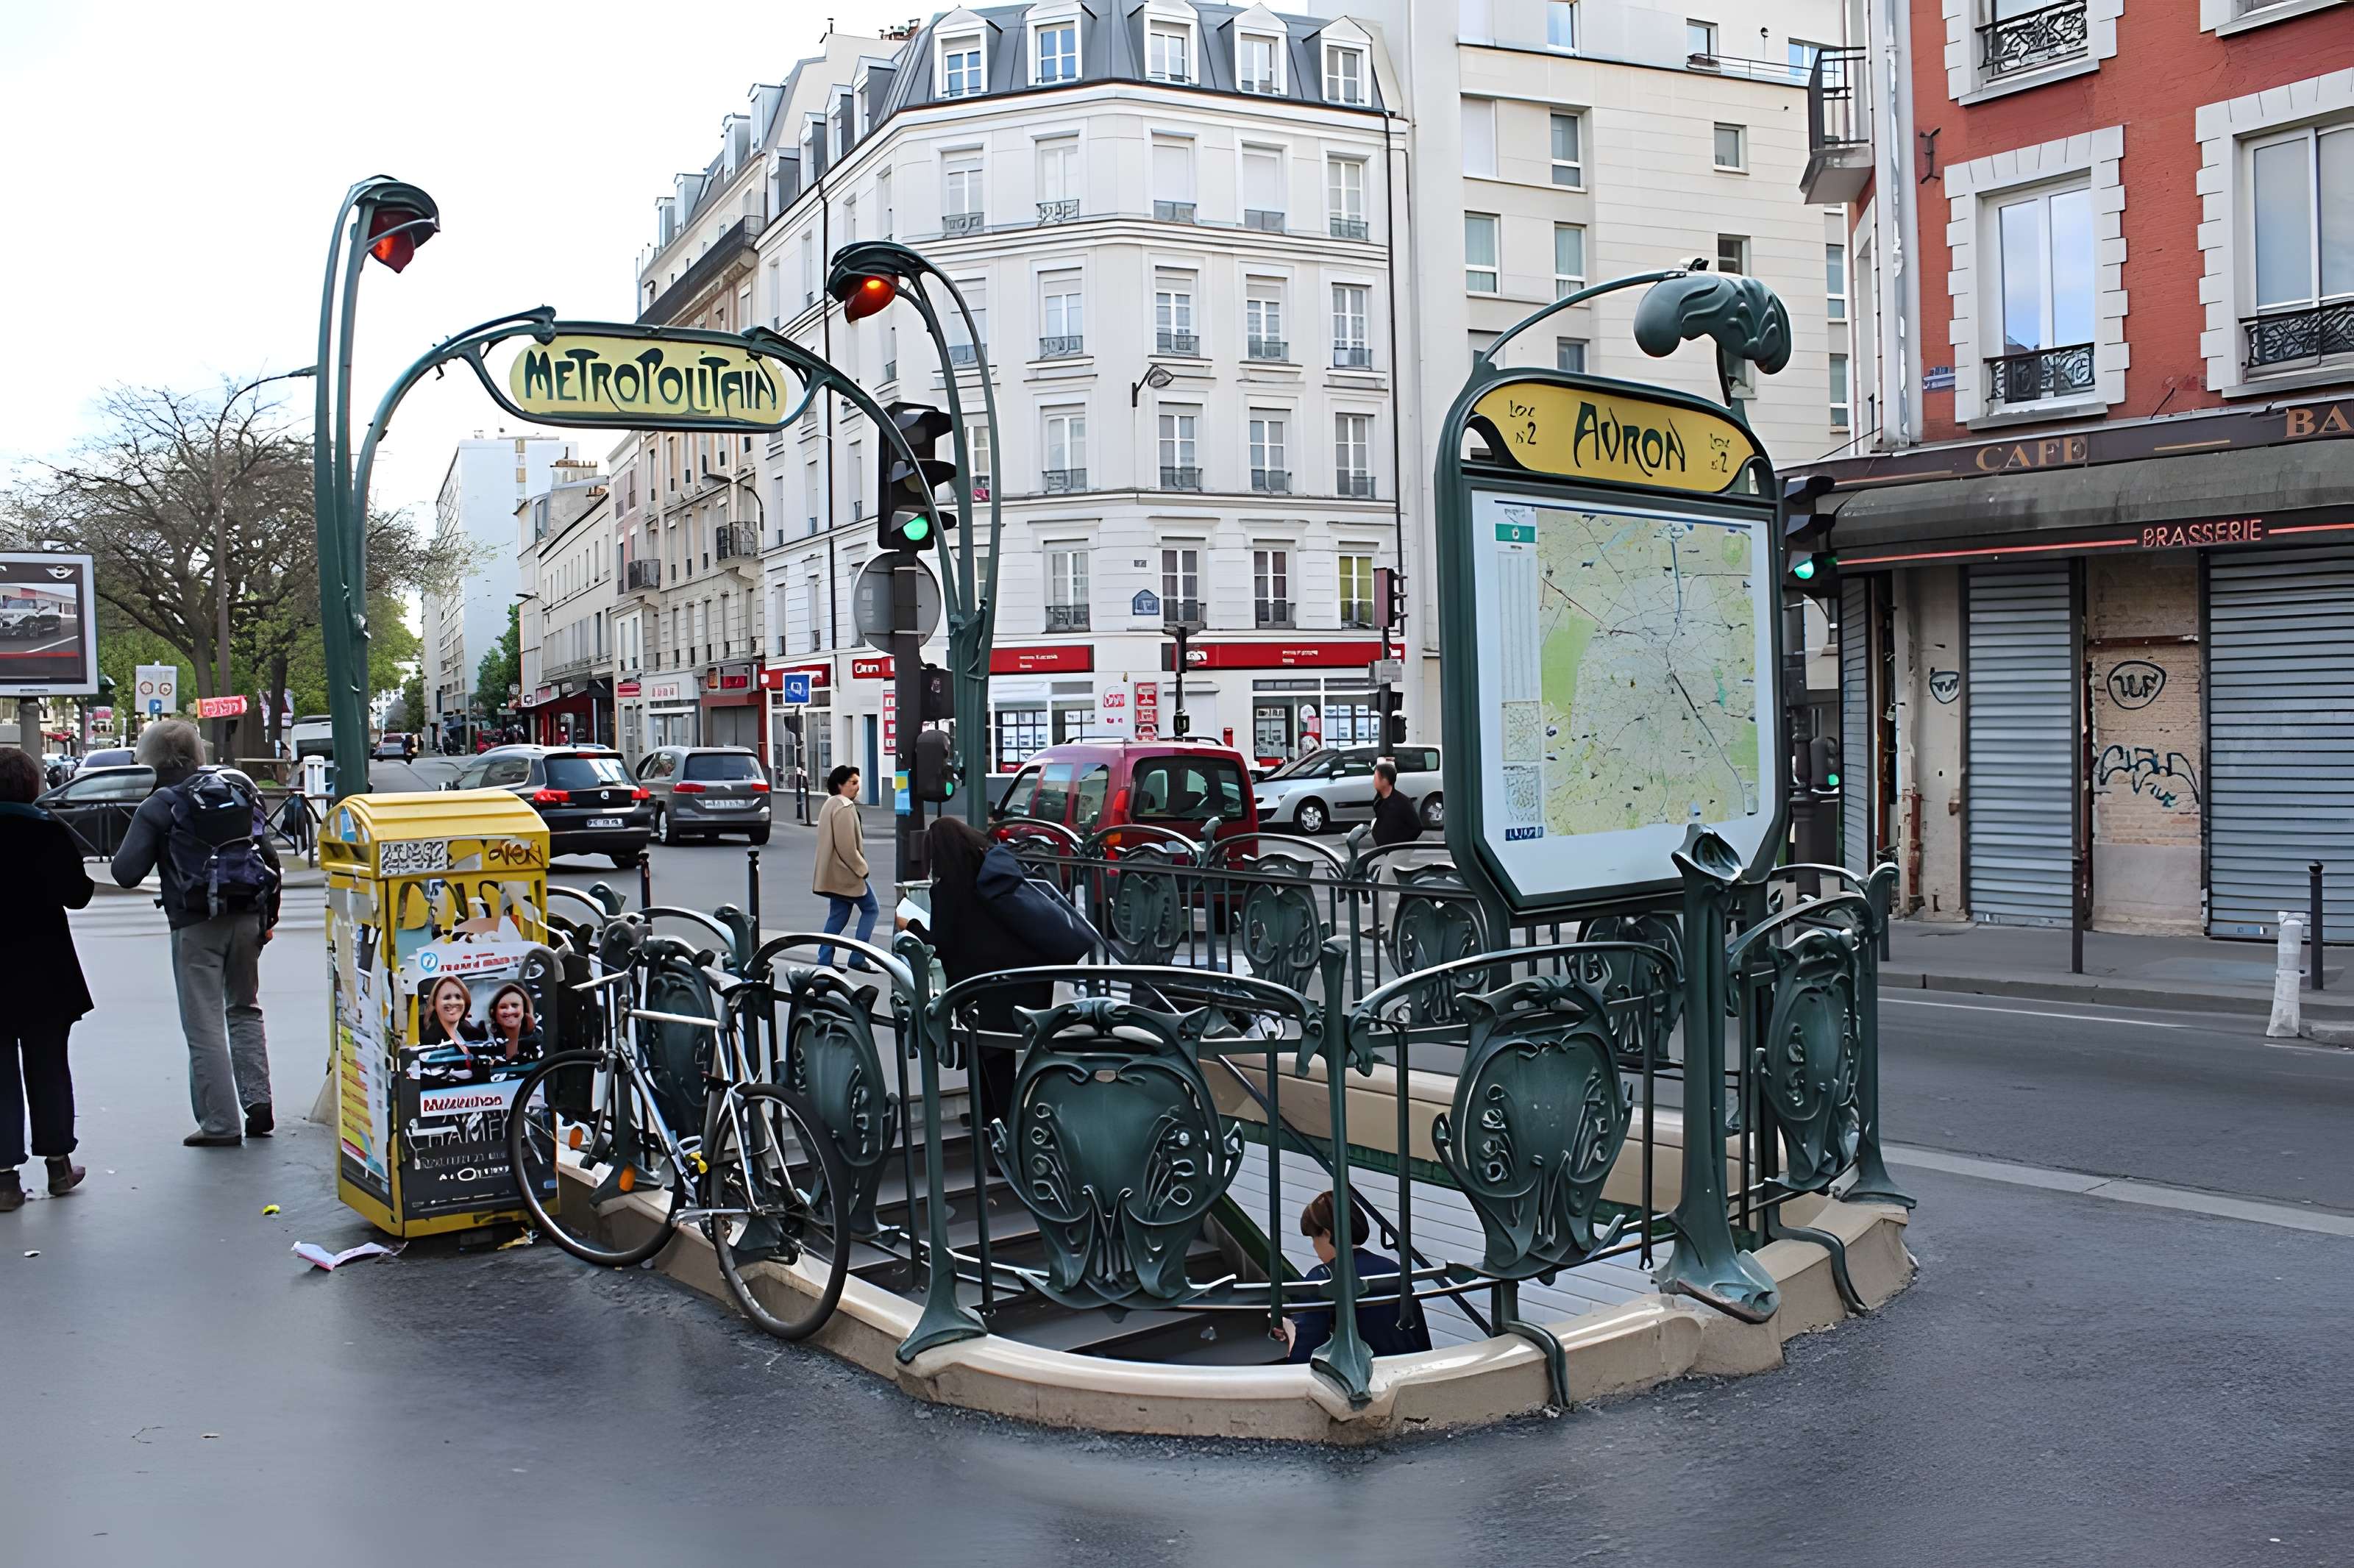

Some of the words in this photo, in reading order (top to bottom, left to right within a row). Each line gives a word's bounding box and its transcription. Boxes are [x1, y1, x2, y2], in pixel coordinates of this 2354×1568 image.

[525, 348, 778, 417] METROPOLITAIN
[1574, 401, 1685, 477] AVRON
[2142, 518, 2262, 548] BRASSERIE
